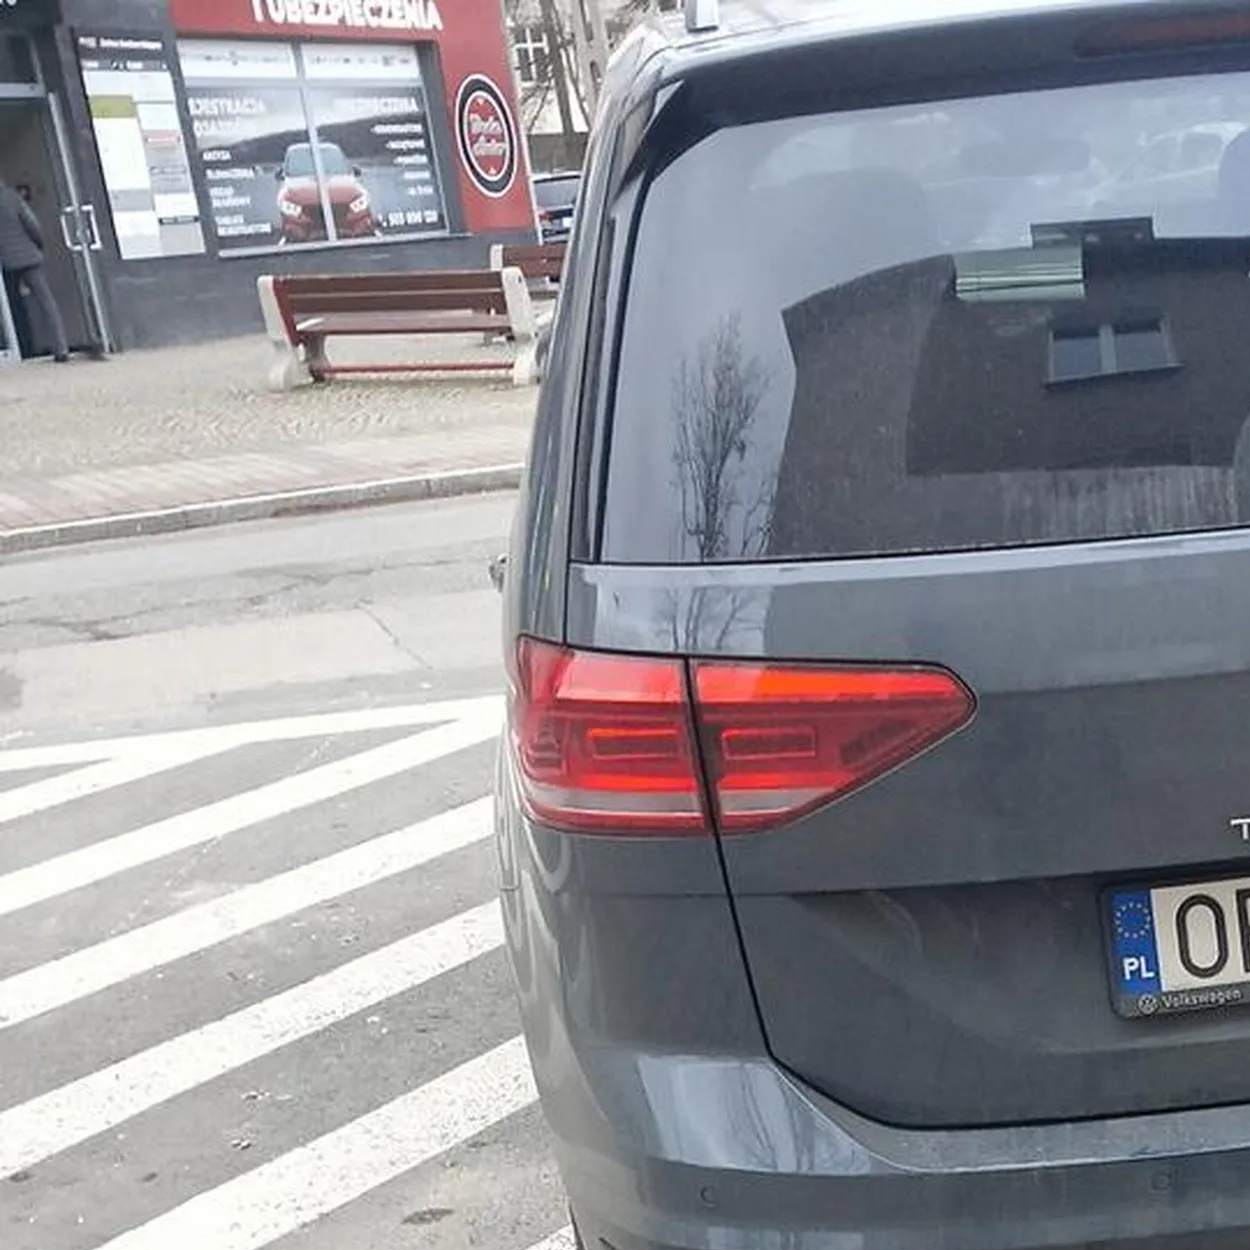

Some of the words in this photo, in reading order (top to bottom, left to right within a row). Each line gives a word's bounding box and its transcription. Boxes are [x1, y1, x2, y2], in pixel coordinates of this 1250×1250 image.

[267, 0, 444, 30] UBEZPIECZENIA
[1123, 956, 1155, 980] PL
[1161, 988, 1242, 1009] Volkswagen
